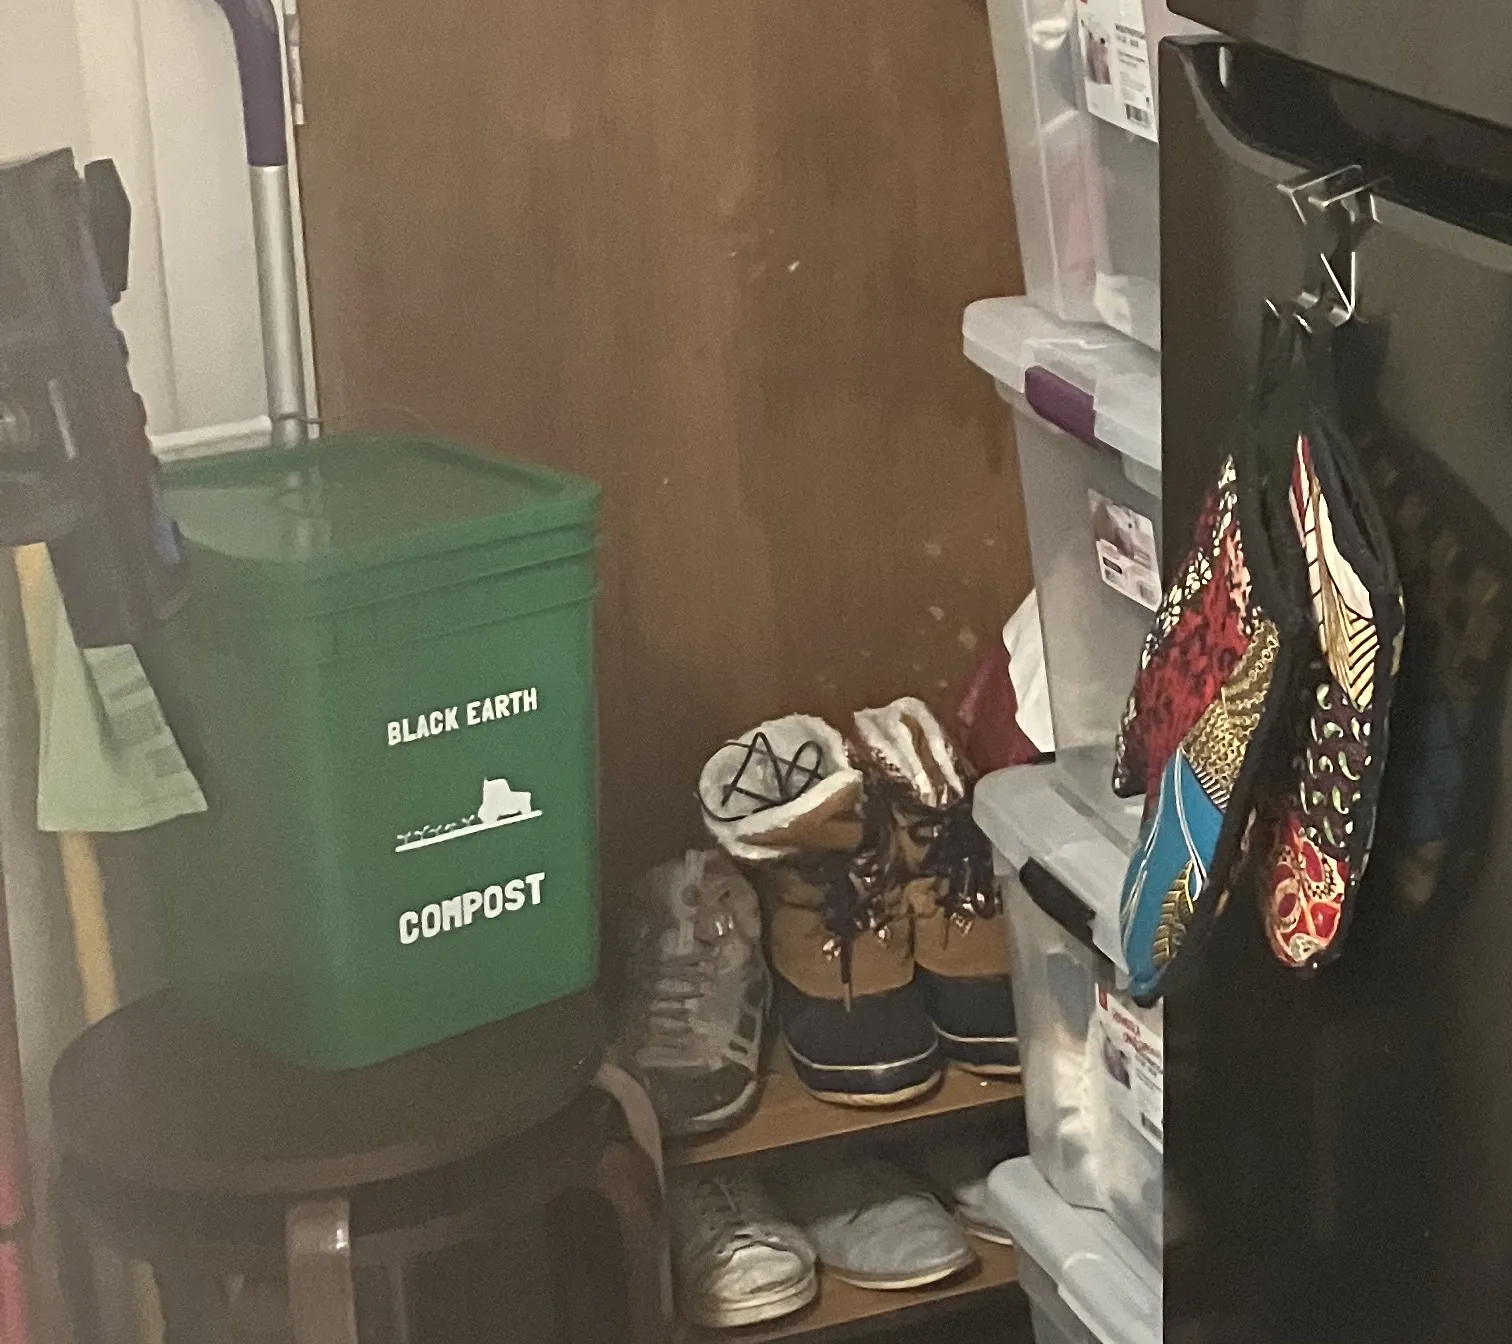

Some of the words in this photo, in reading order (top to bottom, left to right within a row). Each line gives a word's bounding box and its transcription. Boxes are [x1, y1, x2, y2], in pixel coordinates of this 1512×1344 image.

[387, 706, 459, 746] BLACK
[466, 687, 538, 727] EARTH
[399, 872, 546, 945] COMPOST
